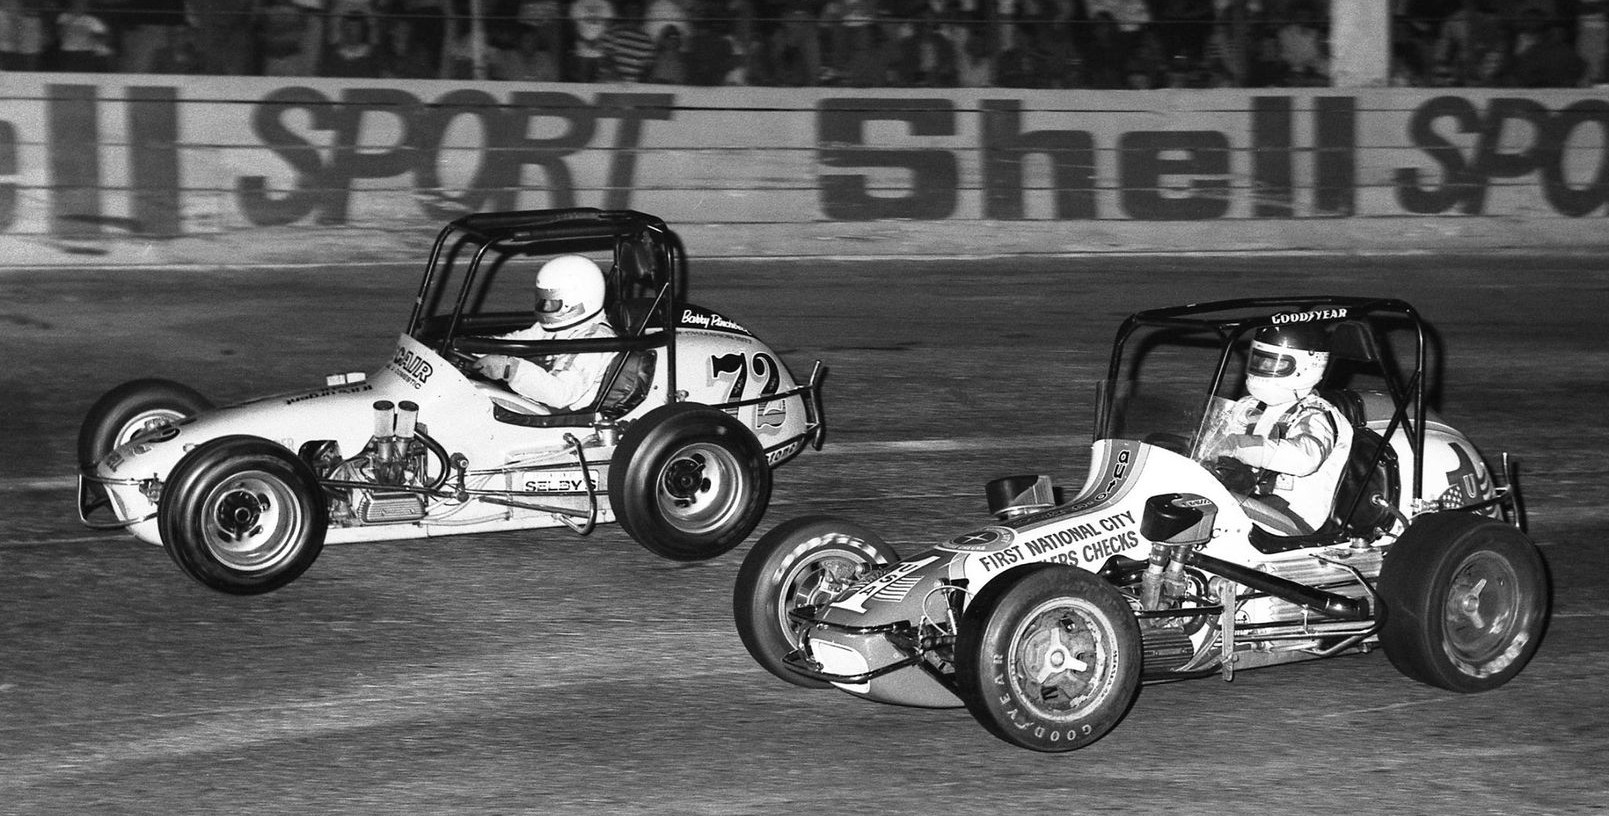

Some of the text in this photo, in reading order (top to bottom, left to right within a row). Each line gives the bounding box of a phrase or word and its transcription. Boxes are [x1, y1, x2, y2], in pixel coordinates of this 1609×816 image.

[237, 86, 674, 226] SPORT
[815, 96, 1357, 220] Shell
[1271, 308, 1347, 324] GOODYEAR
[710, 351, 786, 429] 72
[979, 545, 1026, 572] FIRST
[1024, 523, 1102, 557] NATIONAL
[1100, 510, 1136, 531] CITY
[1081, 530, 1139, 562] CHECKS
[859, 562, 919, 596] USA
[992, 653, 1092, 741] GOODYEAR
